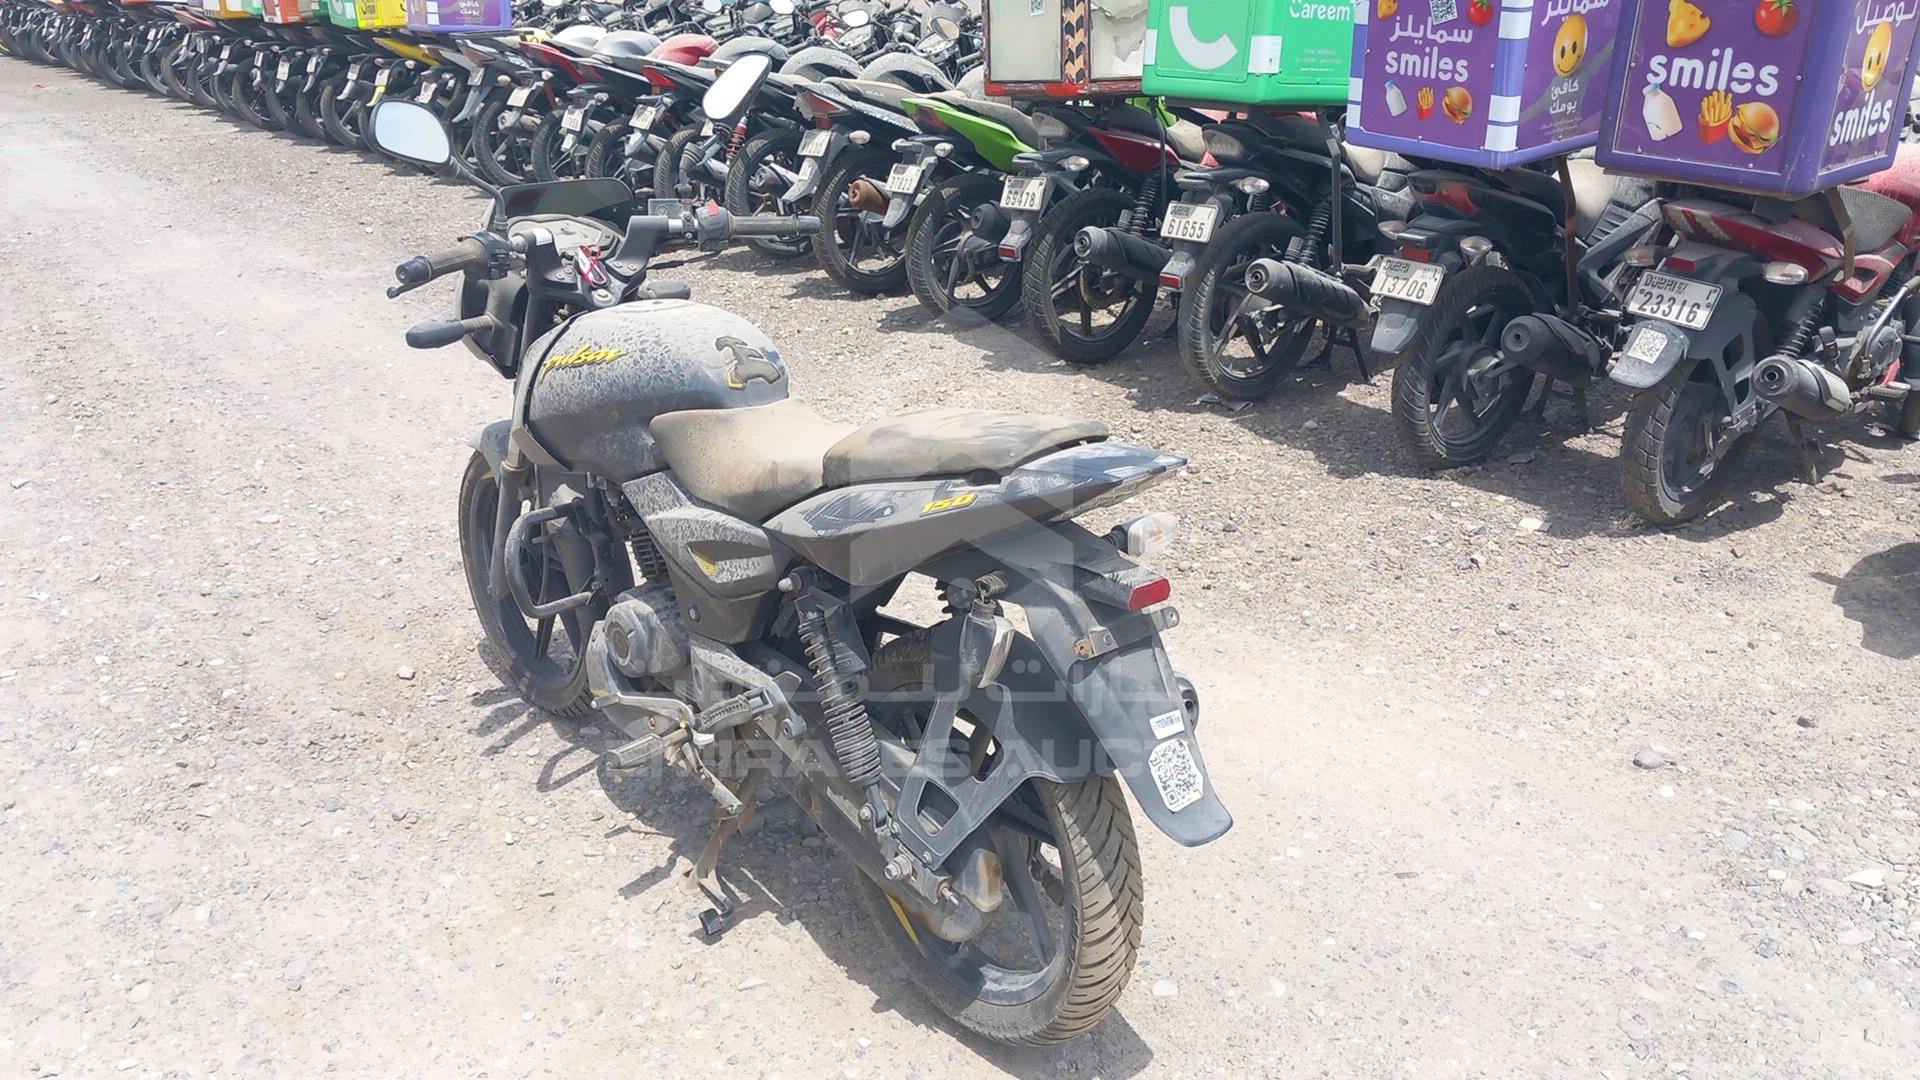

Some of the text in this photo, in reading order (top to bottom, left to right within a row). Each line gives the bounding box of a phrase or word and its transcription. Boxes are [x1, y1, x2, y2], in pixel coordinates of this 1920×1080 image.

[1289, 0, 1350, 21] Careem
[1389, 14, 1473, 45] سمايلز
[1385, 46, 1468, 83] smiles
[1646, 47, 1779, 96] smiles
[1549, 99, 1577, 115] يومك
[1829, 89, 1893, 147] smiles
[1005, 190, 1036, 208] 69478
[1167, 219, 1206, 239] 61655
[1379, 274, 1428, 300] 13706
[1637, 291, 1701, 324] 23316
[920, 492, 977, 514] 150
